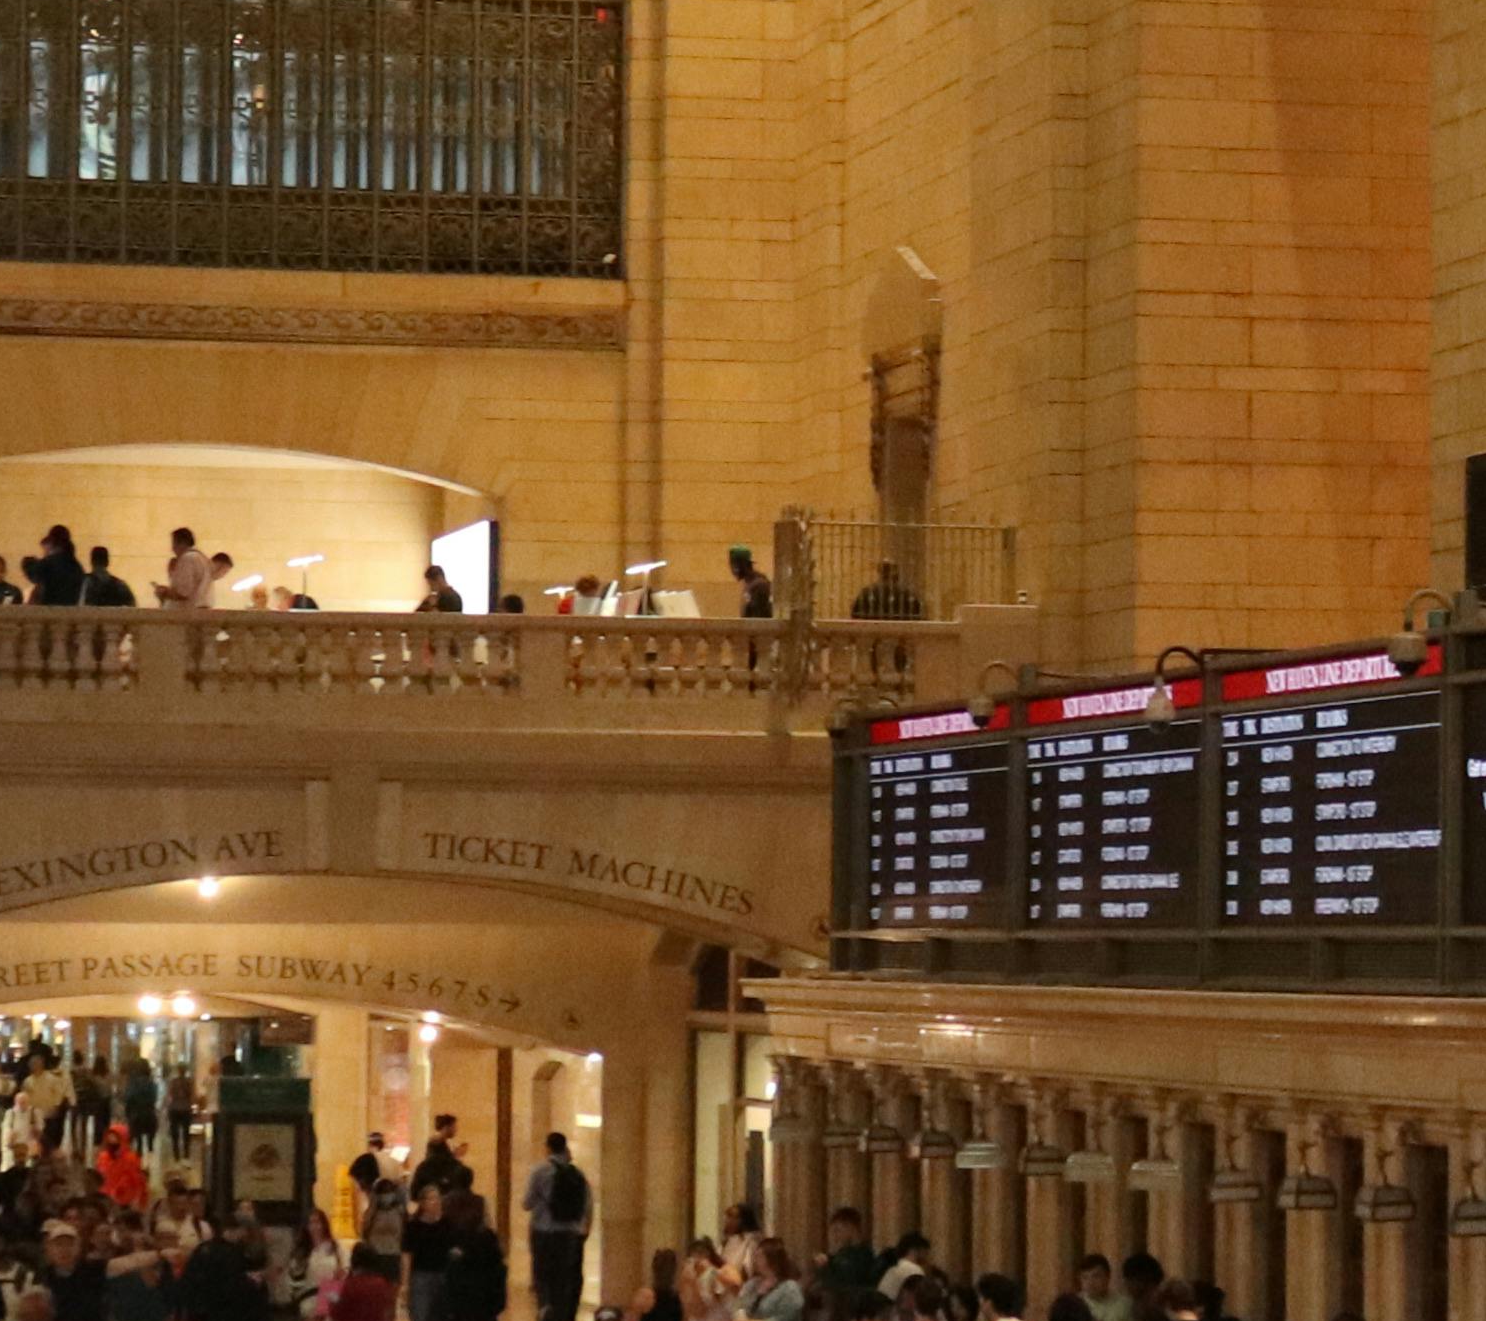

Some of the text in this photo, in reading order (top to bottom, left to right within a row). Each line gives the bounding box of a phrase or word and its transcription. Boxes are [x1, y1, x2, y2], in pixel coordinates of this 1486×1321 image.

[213, 831, 283, 860] AVE
[423, 832, 755, 915] TICKET MACHINES
[81, 953, 218, 980] PASSAGE
[237, 955, 372, 986] SUBWAY
